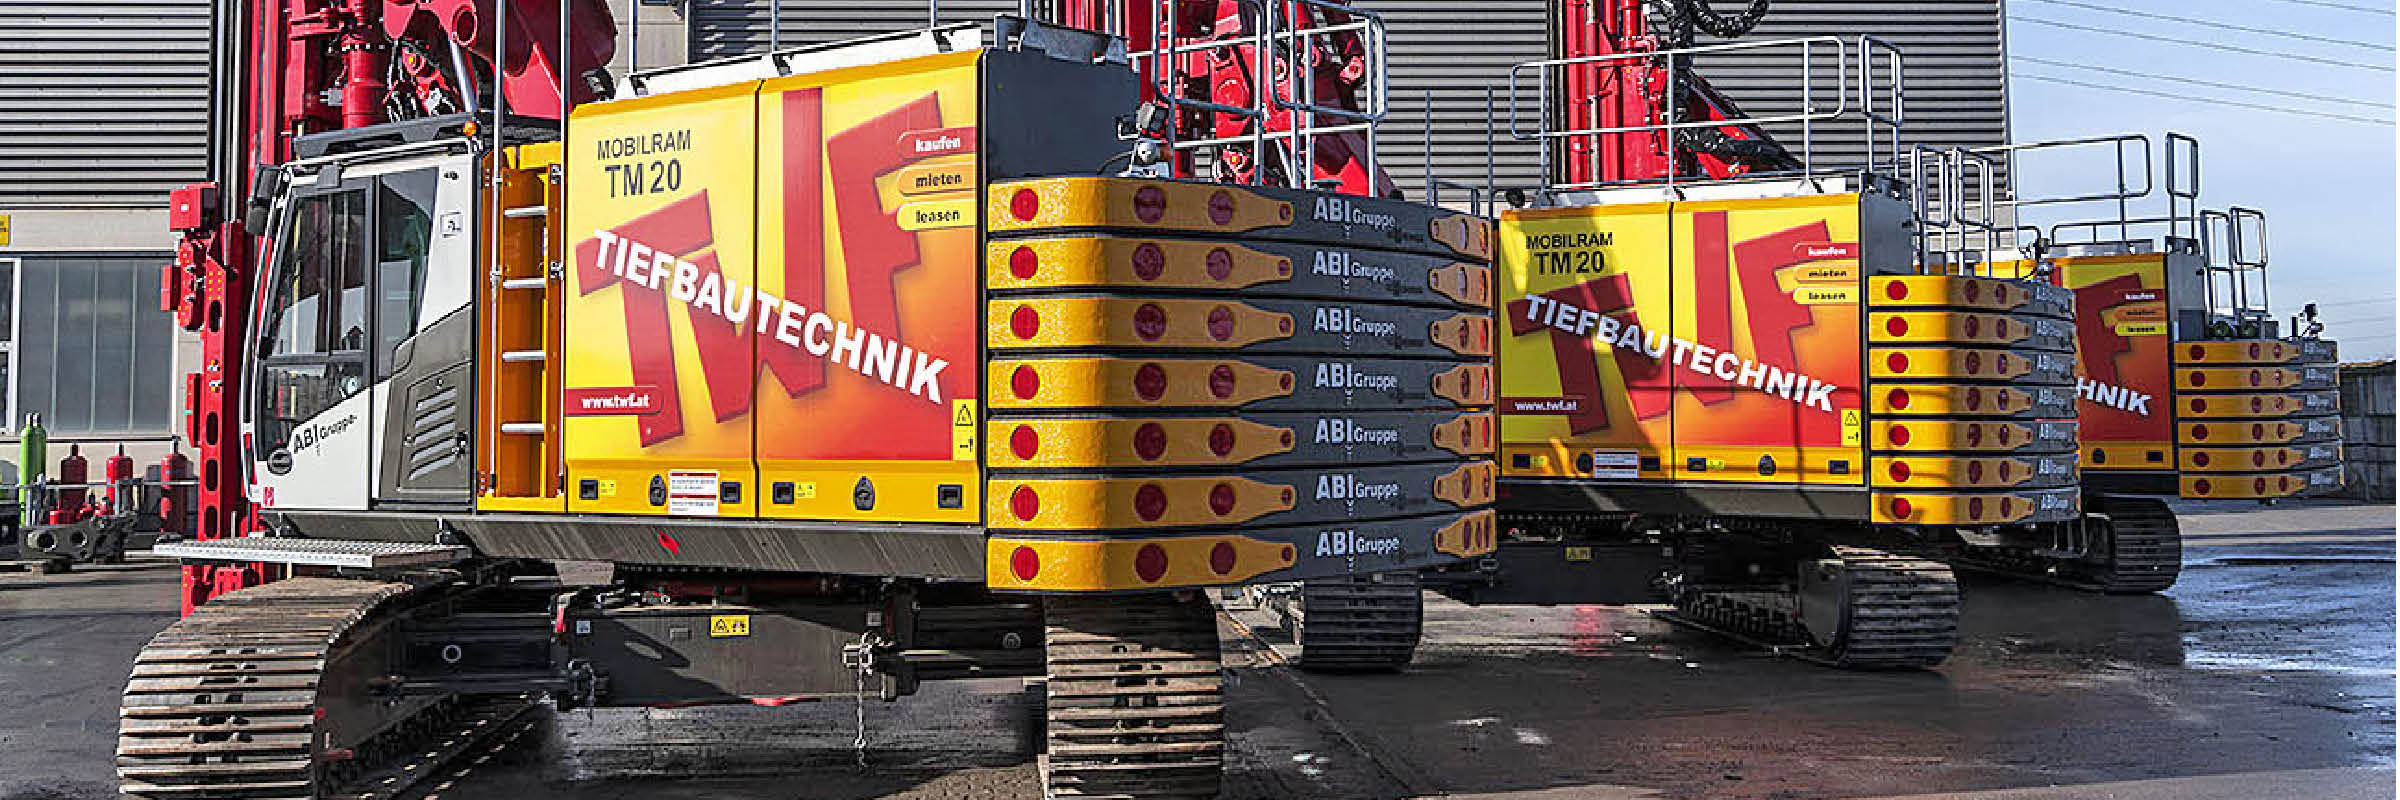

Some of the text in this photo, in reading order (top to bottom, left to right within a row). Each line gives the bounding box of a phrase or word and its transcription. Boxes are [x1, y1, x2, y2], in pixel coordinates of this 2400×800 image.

[597, 129, 691, 160] MOBILRAM
[915, 135, 961, 153] kaufen
[605, 158, 682, 198] TM 20
[915, 172, 962, 188] mieten
[915, 209, 961, 224] leasen
[1352, 208, 1396, 230] Gruppe
[1525, 232, 1613, 250] MOBILRAM
[1350, 261, 1394, 281] Gruppe
[1534, 250, 1605, 275] TM 20
[593, 229, 950, 404] TIEFBAUTECHNIK
[1352, 318, 1396, 337] Gruppe
[1524, 293, 1838, 411] TIEFBAUTECHNIK
[1353, 372, 1398, 391] Gruppe
[581, 392, 649, 408] www.twf.at
[1353, 426, 1398, 445] Gruppe
[1355, 481, 1400, 500] Gruppe
[1356, 535, 1400, 555] Gruppe
